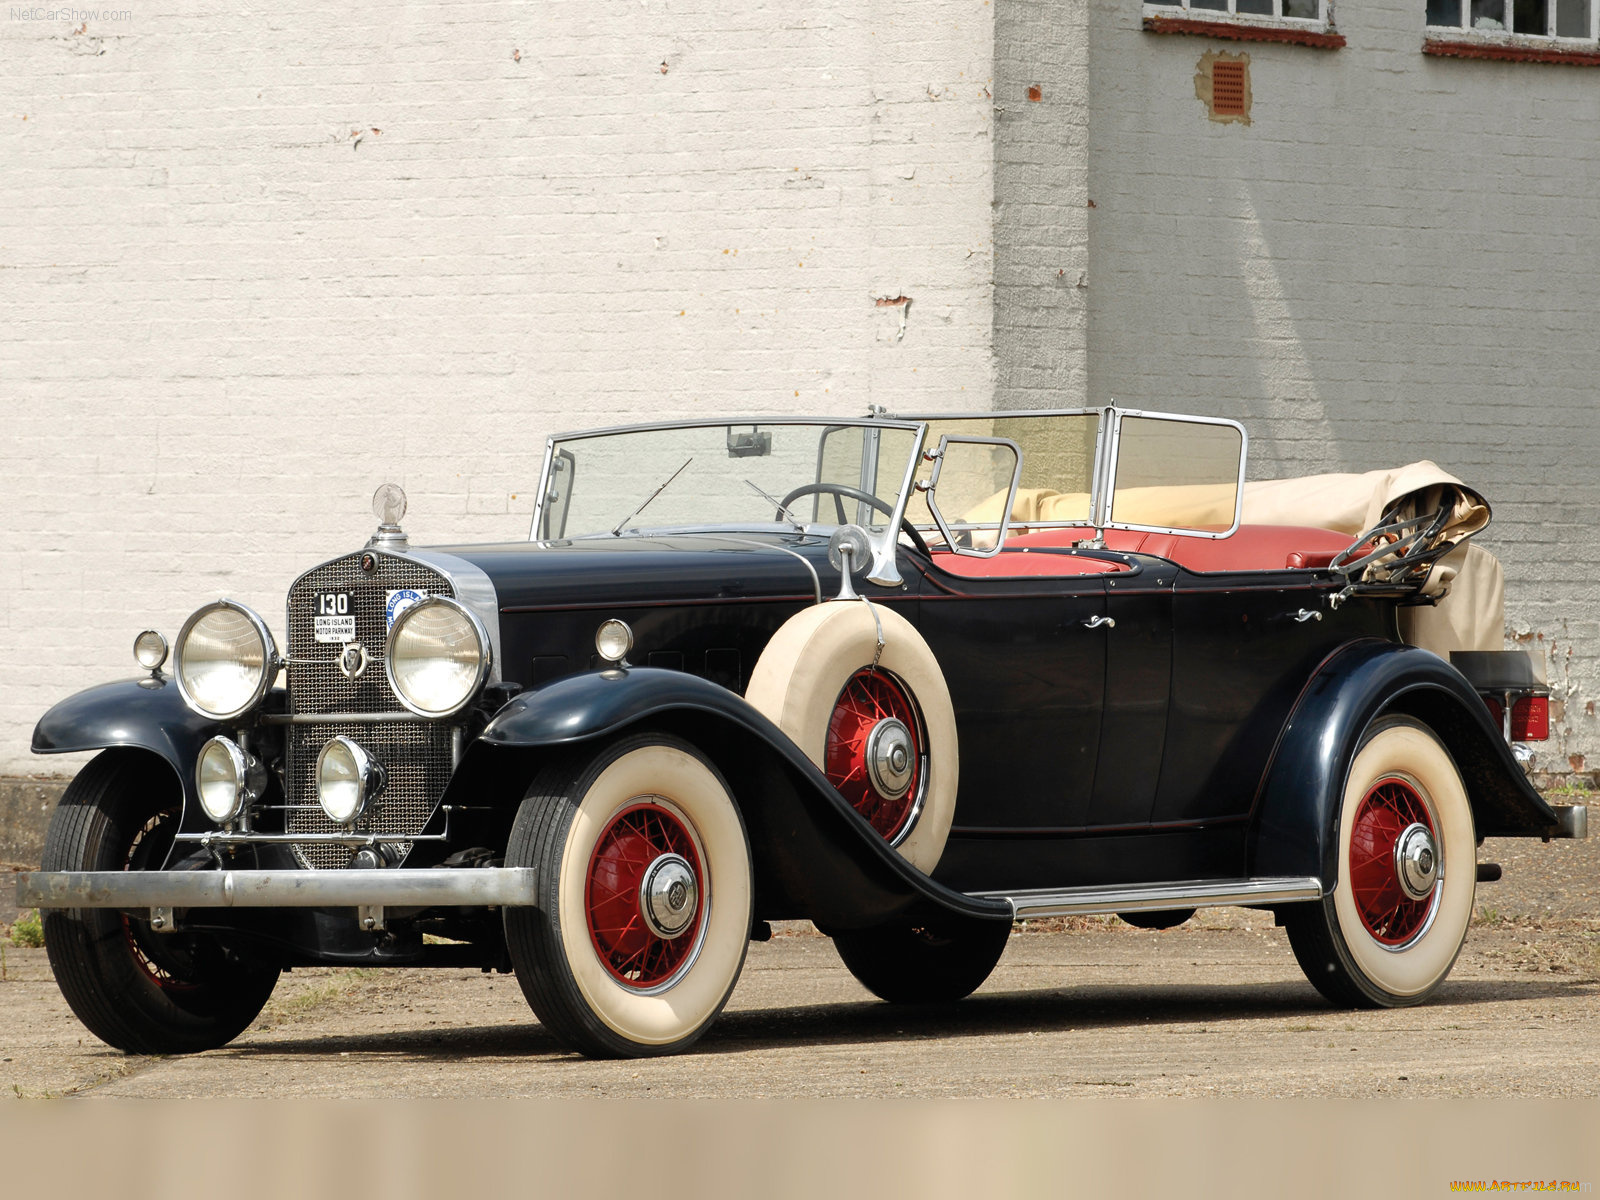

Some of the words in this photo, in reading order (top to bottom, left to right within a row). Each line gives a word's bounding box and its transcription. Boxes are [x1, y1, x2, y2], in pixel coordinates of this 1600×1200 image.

[320, 593, 348, 615] 130
[388, 593, 401, 612] LONG
[402, 591, 420, 602] ISLA
[316, 618, 331, 626] LONG
[332, 618, 353, 626] ISLAND
[332, 627, 353, 635] PARKWAY
